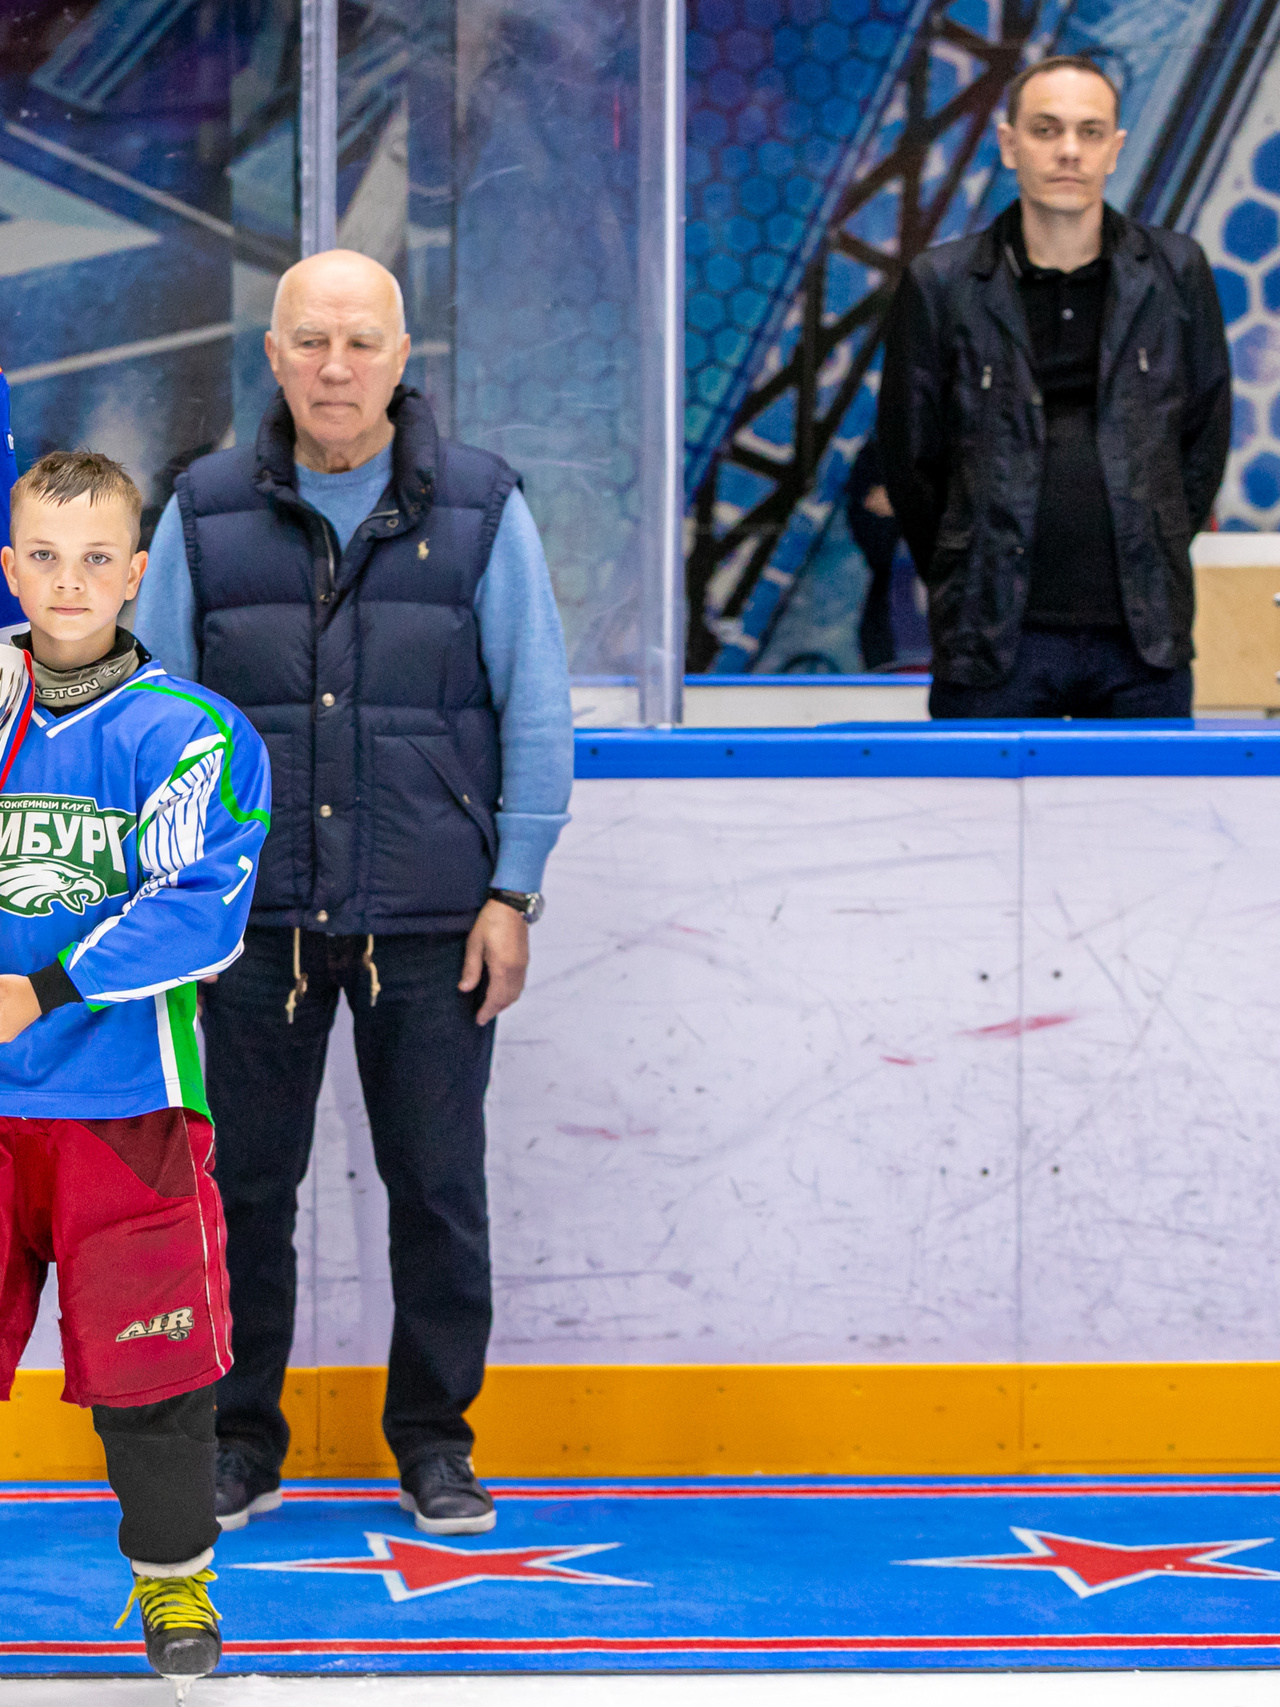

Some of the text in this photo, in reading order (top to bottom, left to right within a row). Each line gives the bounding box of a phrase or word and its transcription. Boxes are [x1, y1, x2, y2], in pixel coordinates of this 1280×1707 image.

[61, 802, 92, 813] КЛУБ
[221, 855, 253, 905] 7
[116, 1307, 195, 1342] AIR
